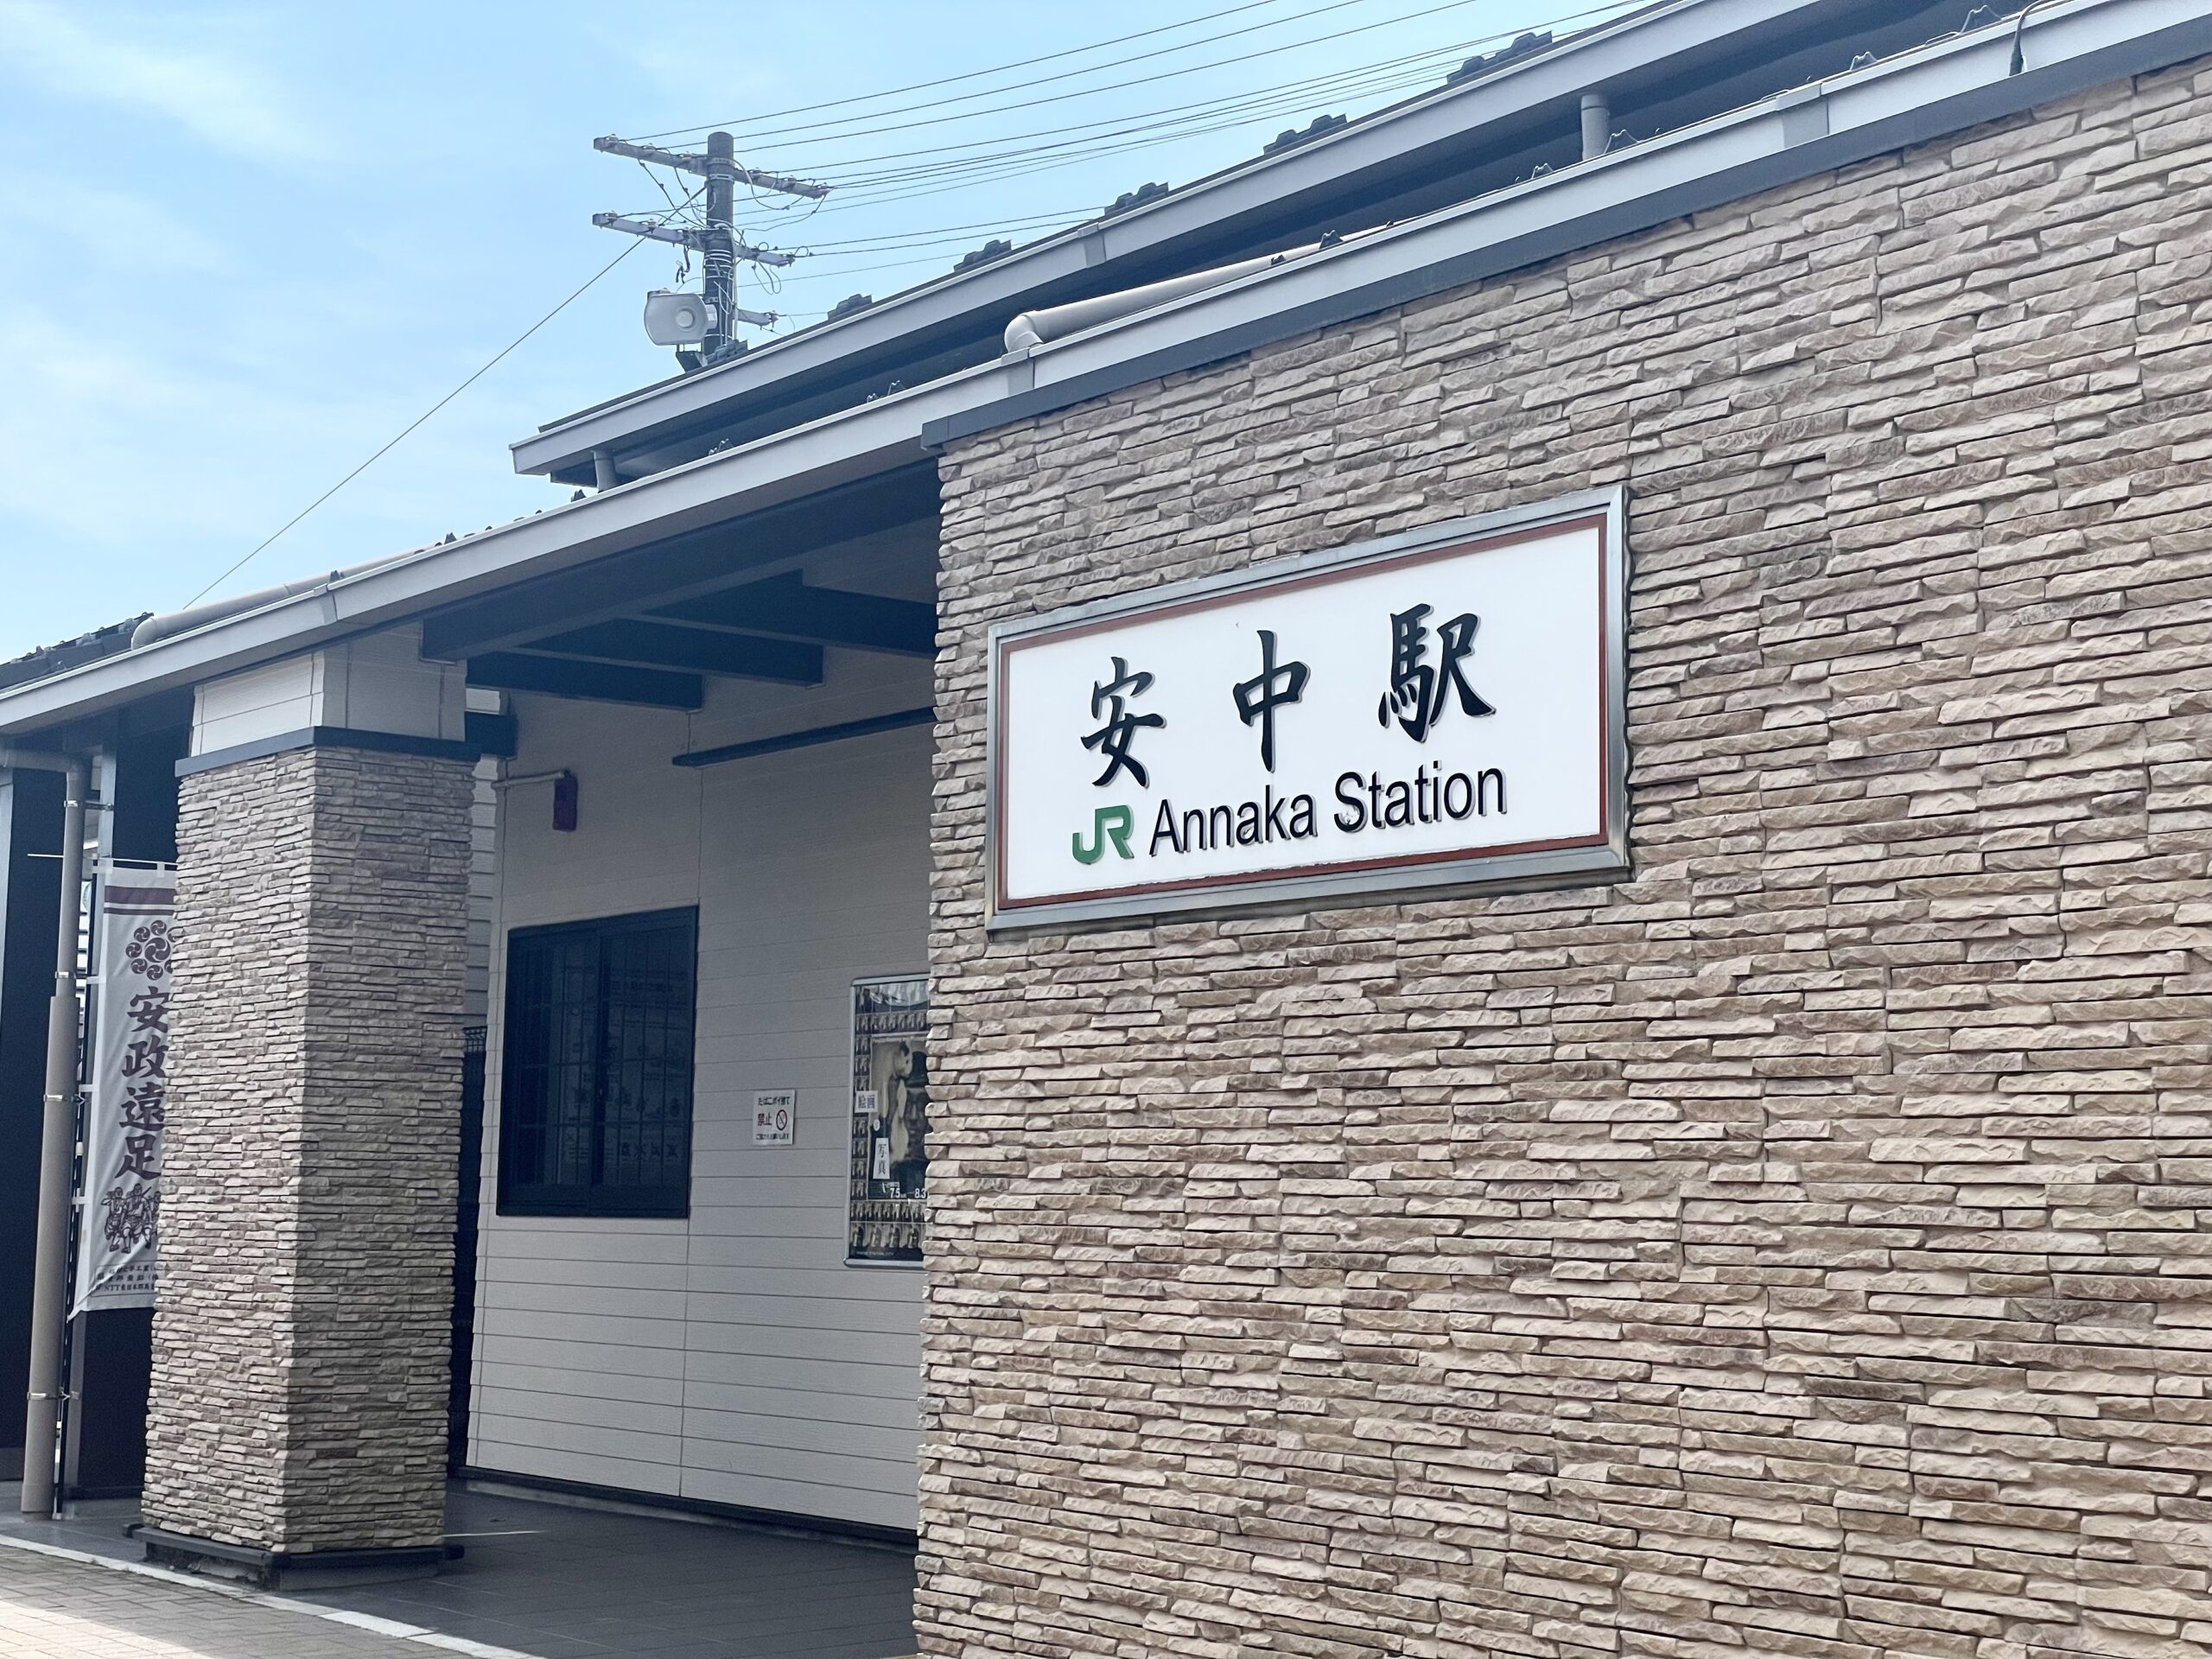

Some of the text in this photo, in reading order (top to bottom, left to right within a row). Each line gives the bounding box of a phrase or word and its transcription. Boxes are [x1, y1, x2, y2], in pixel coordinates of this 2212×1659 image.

[1079, 602, 1495, 788] 安中駅
[1071, 760, 1507, 865] JR Annaka Station
[114, 985, 170, 1180] 安政遠足
[757, 1111, 772, 1127] 禁止
[877, 1143, 887, 1175] 写真
